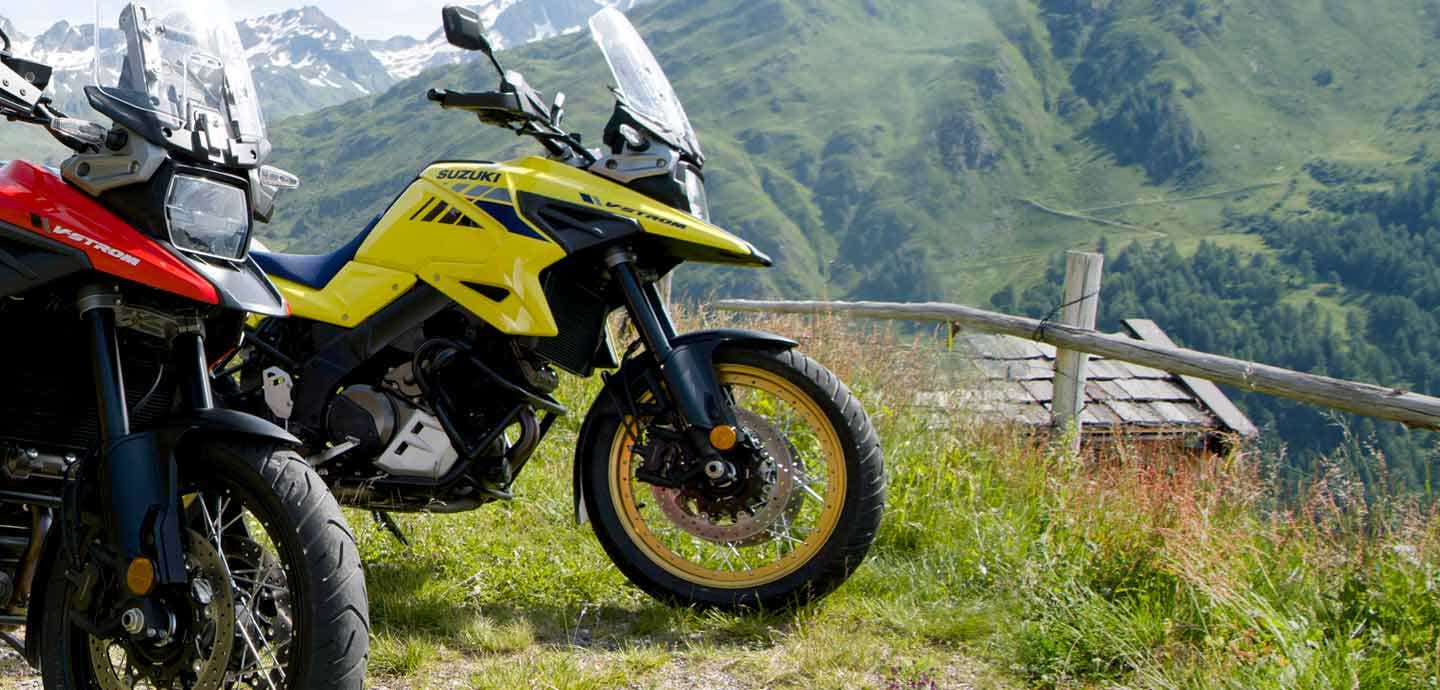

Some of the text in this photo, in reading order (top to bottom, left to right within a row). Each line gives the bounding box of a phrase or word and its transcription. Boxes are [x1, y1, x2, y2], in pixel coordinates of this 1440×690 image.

[436, 169, 502, 183] SUZUKI
[606, 202, 687, 229] V-STROM
[52, 225, 141, 266] V-STROM
